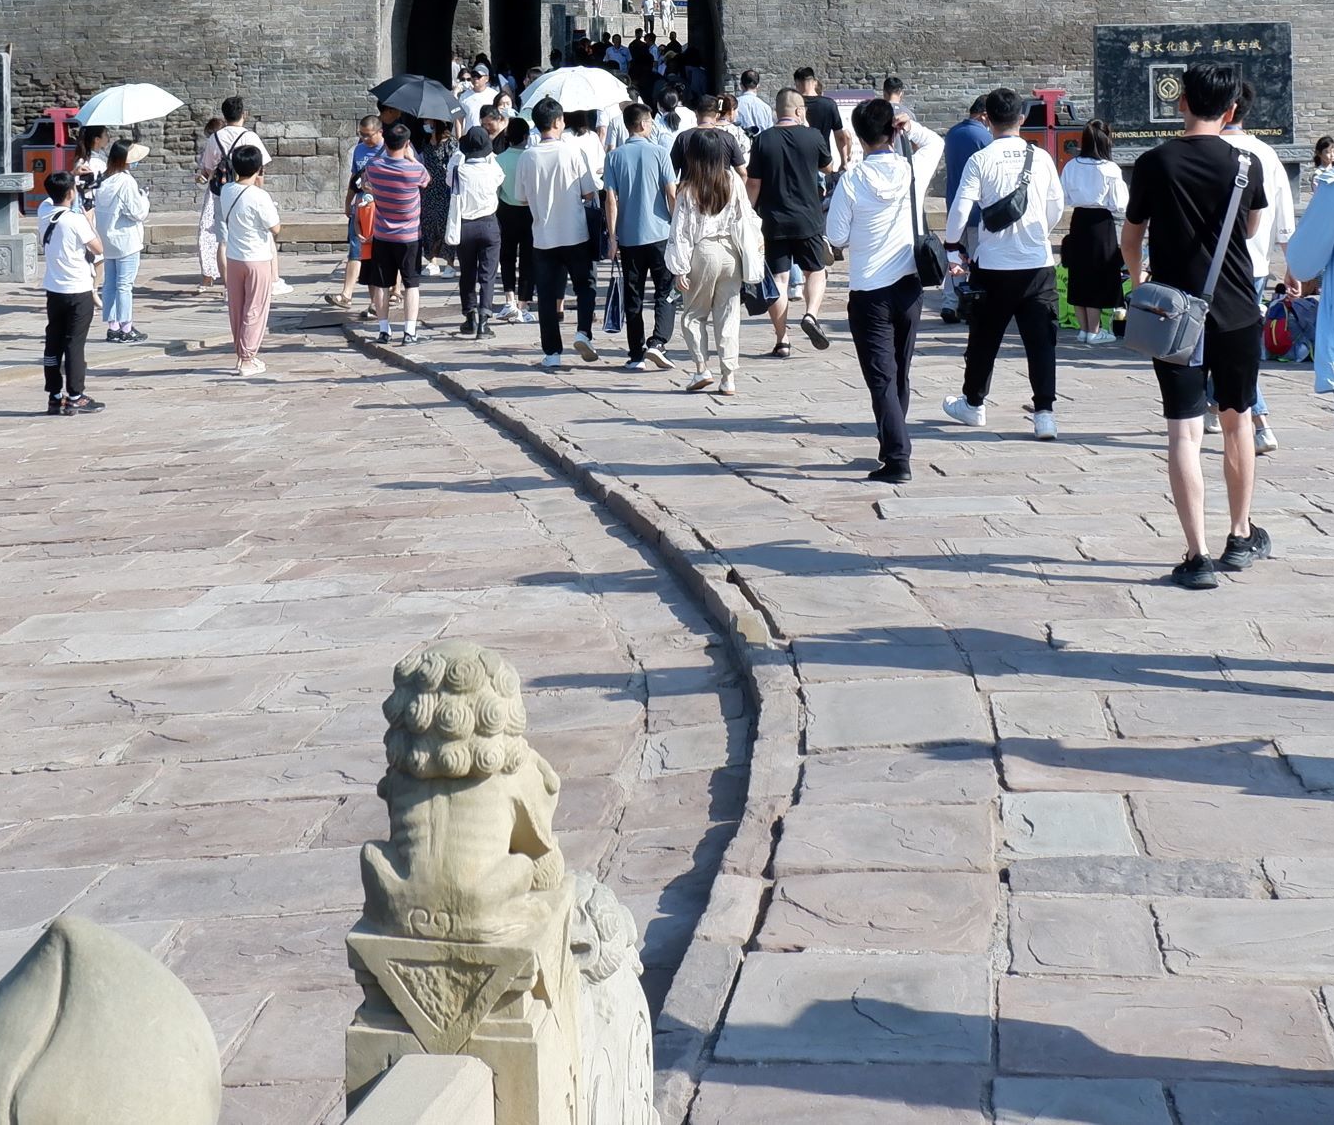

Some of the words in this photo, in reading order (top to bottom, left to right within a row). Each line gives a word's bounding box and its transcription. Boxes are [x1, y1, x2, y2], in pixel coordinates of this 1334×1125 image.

[1127, 39, 1203, 53] 世界文化遗产
[1211, 38, 1263, 53] 平遥古城
